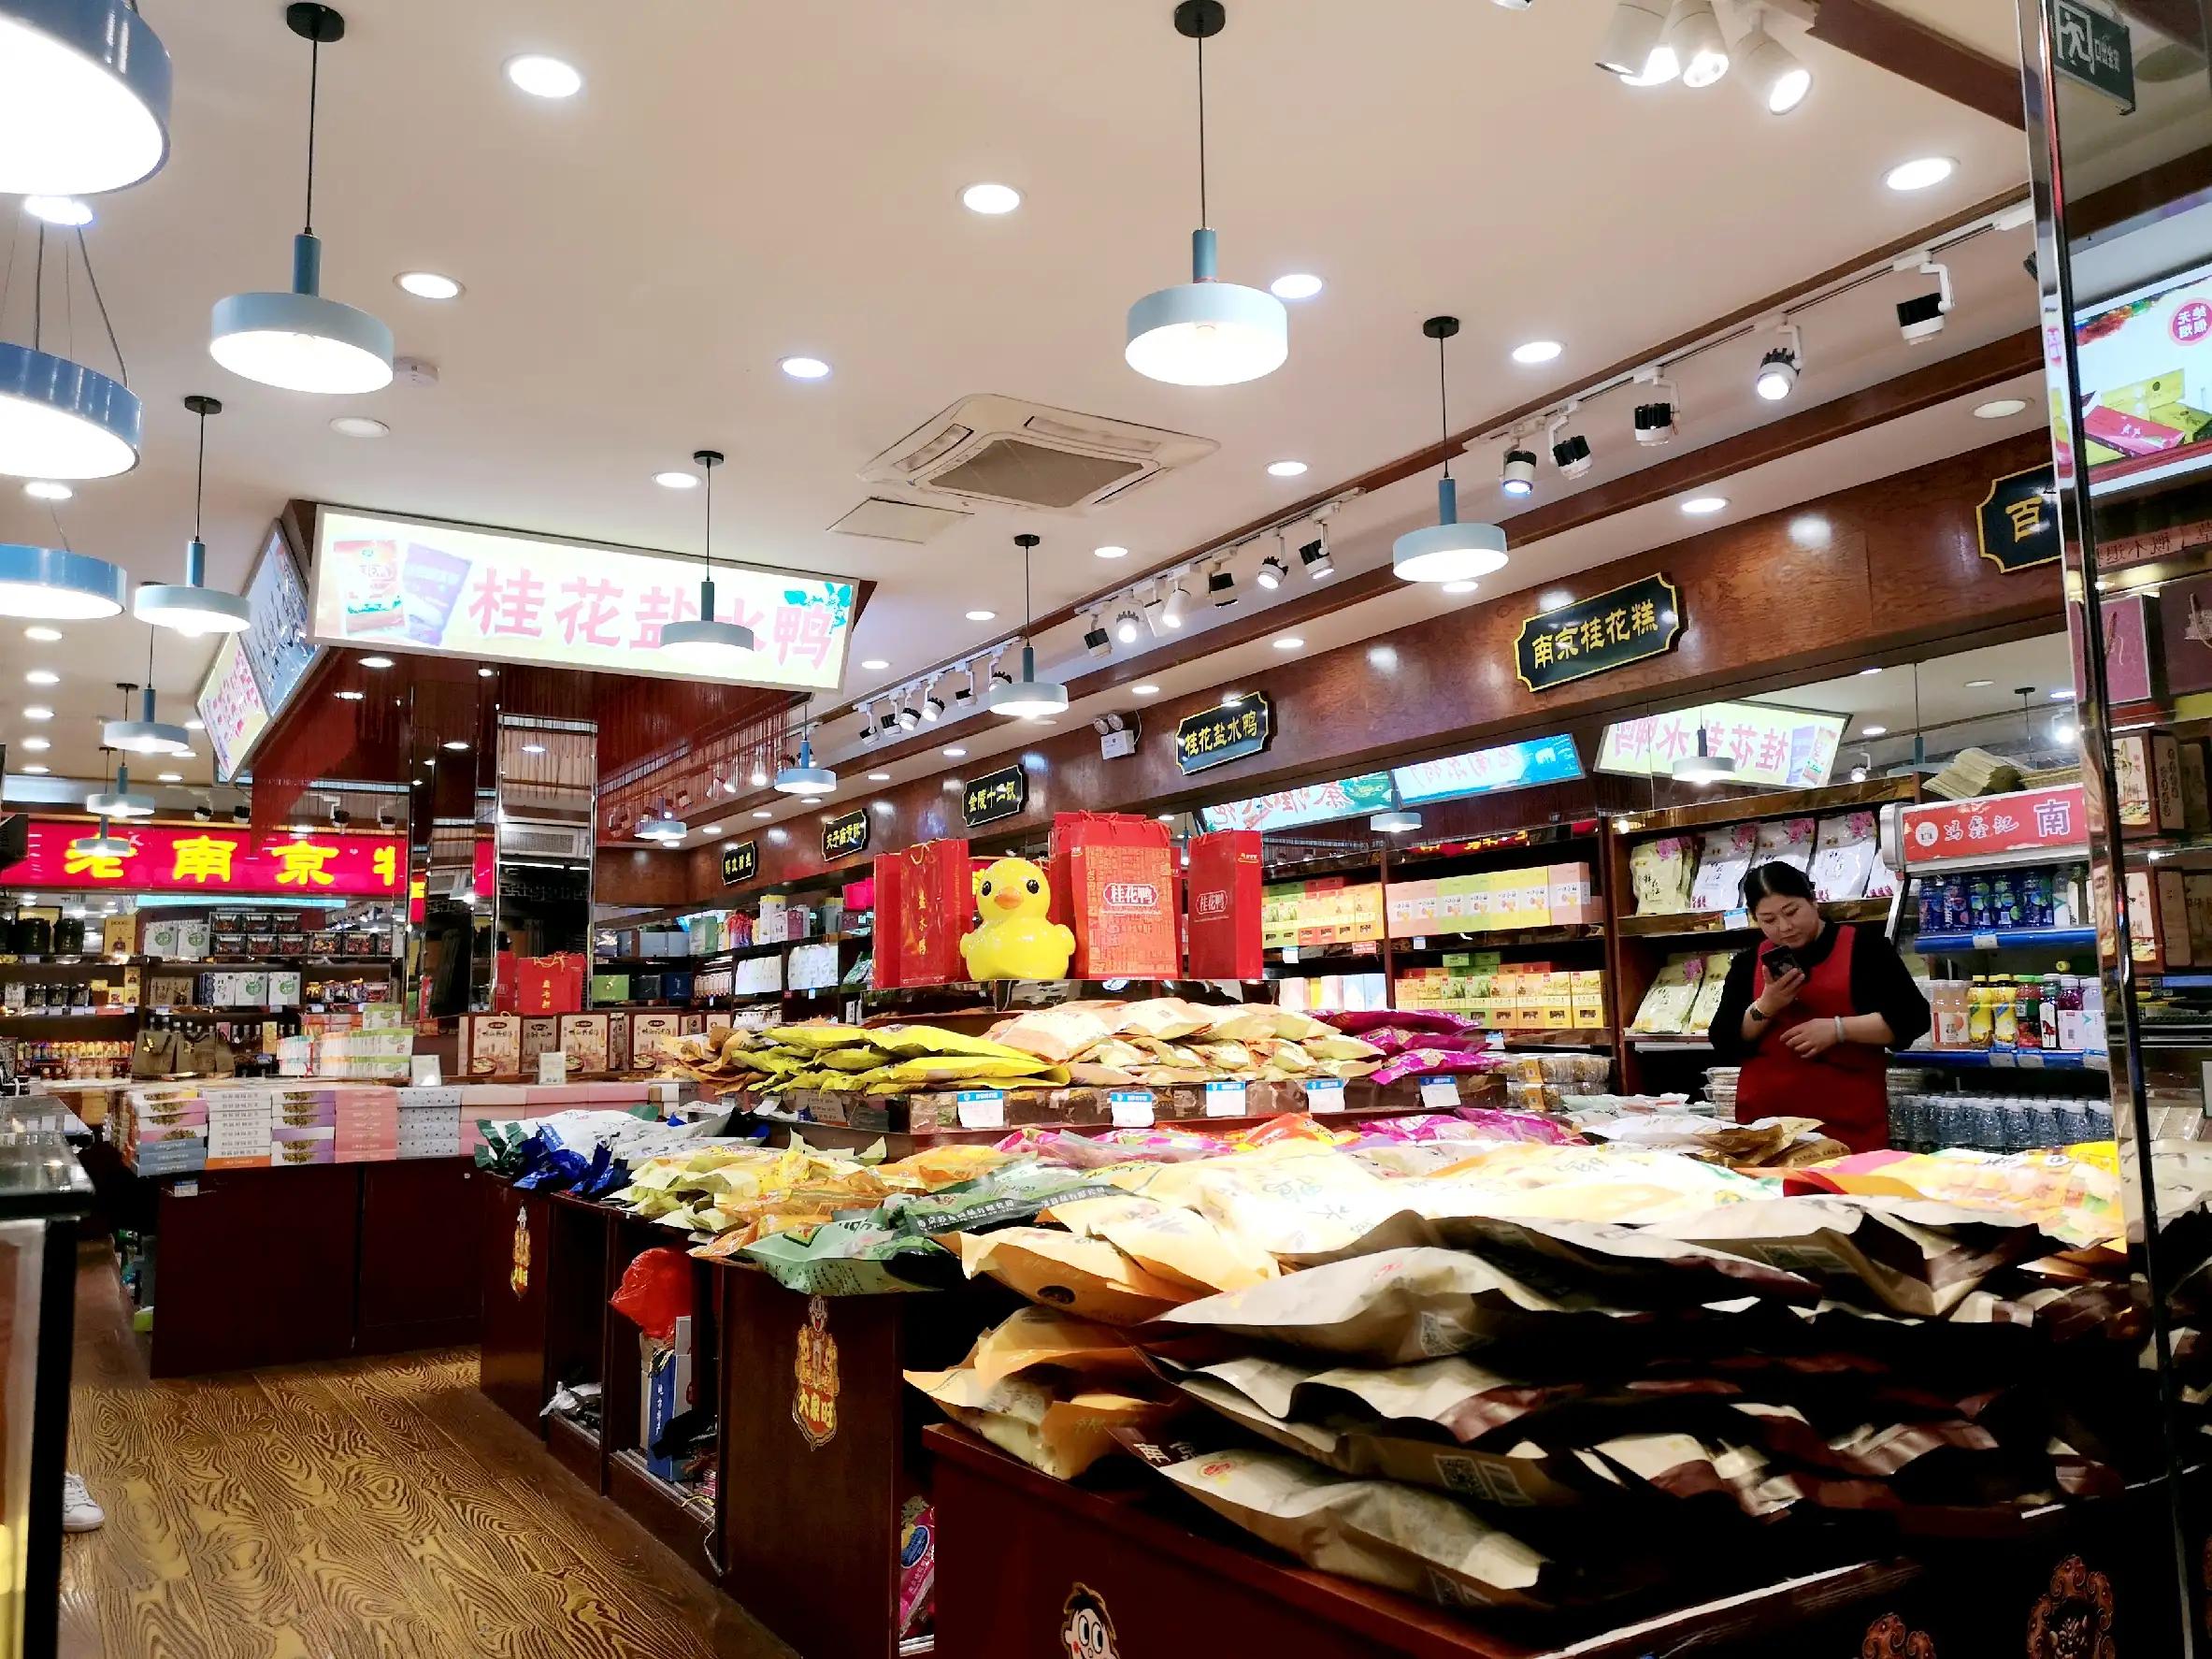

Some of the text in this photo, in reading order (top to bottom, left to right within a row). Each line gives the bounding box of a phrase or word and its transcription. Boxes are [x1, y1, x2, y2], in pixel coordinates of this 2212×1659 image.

[467, 566, 835, 670] 桂花盐水鸭
[1531, 599, 1658, 669] 南京桂花糕
[1185, 709, 1258, 757] 桂花盐水鸭
[2033, 799, 2070, 838] 南
[1111, 885, 1153, 905] 桂花鸭
